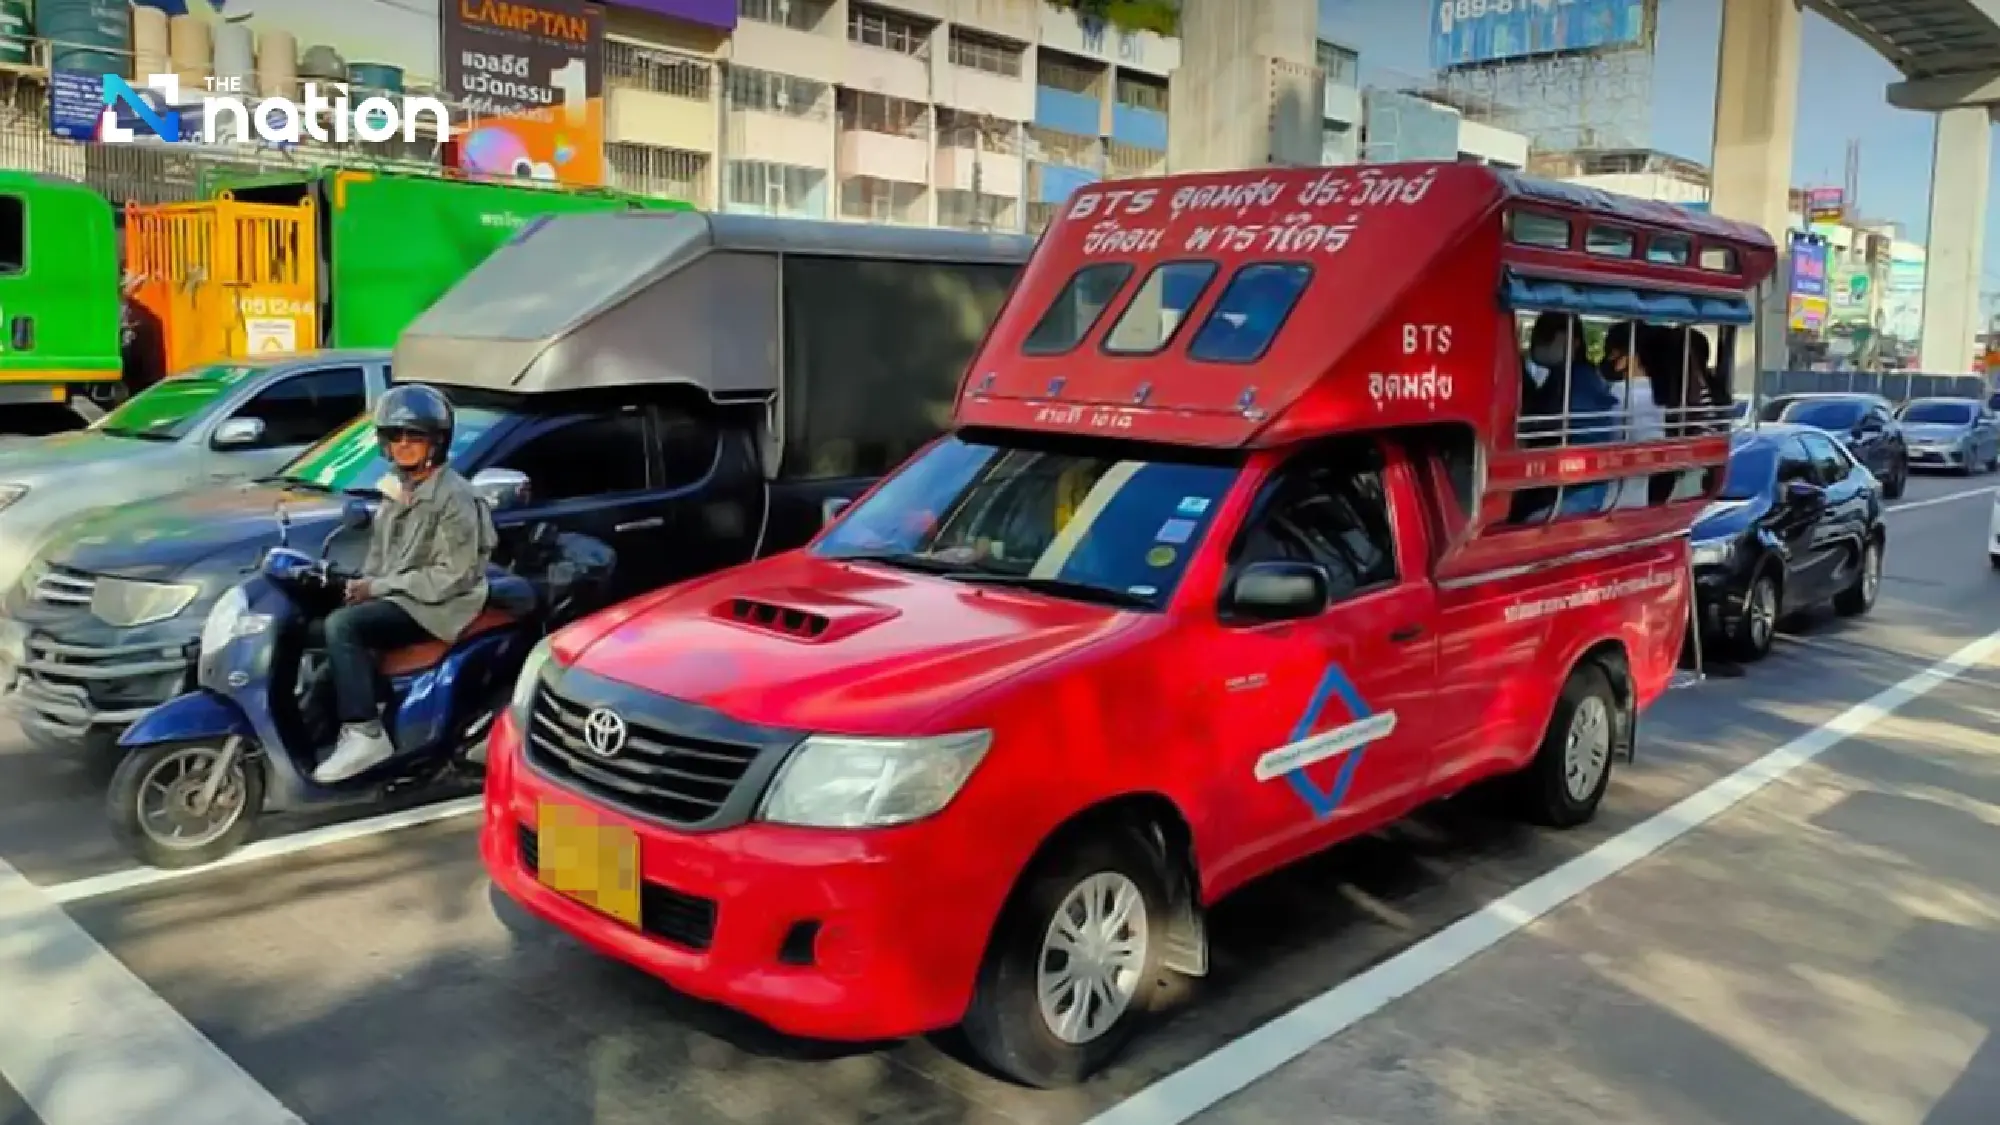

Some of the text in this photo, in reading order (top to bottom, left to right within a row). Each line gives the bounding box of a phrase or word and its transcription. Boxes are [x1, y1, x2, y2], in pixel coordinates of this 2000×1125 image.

[462, 72, 553, 103] นวัตกรรม
[550, 58, 587, 128] 1
[1066, 188, 1161, 220] BTS
[1170, 176, 1286, 221] อุดมสุข
[1402, 323, 1452, 354] BTS
[1368, 364, 1453, 412] อุดมสุข
